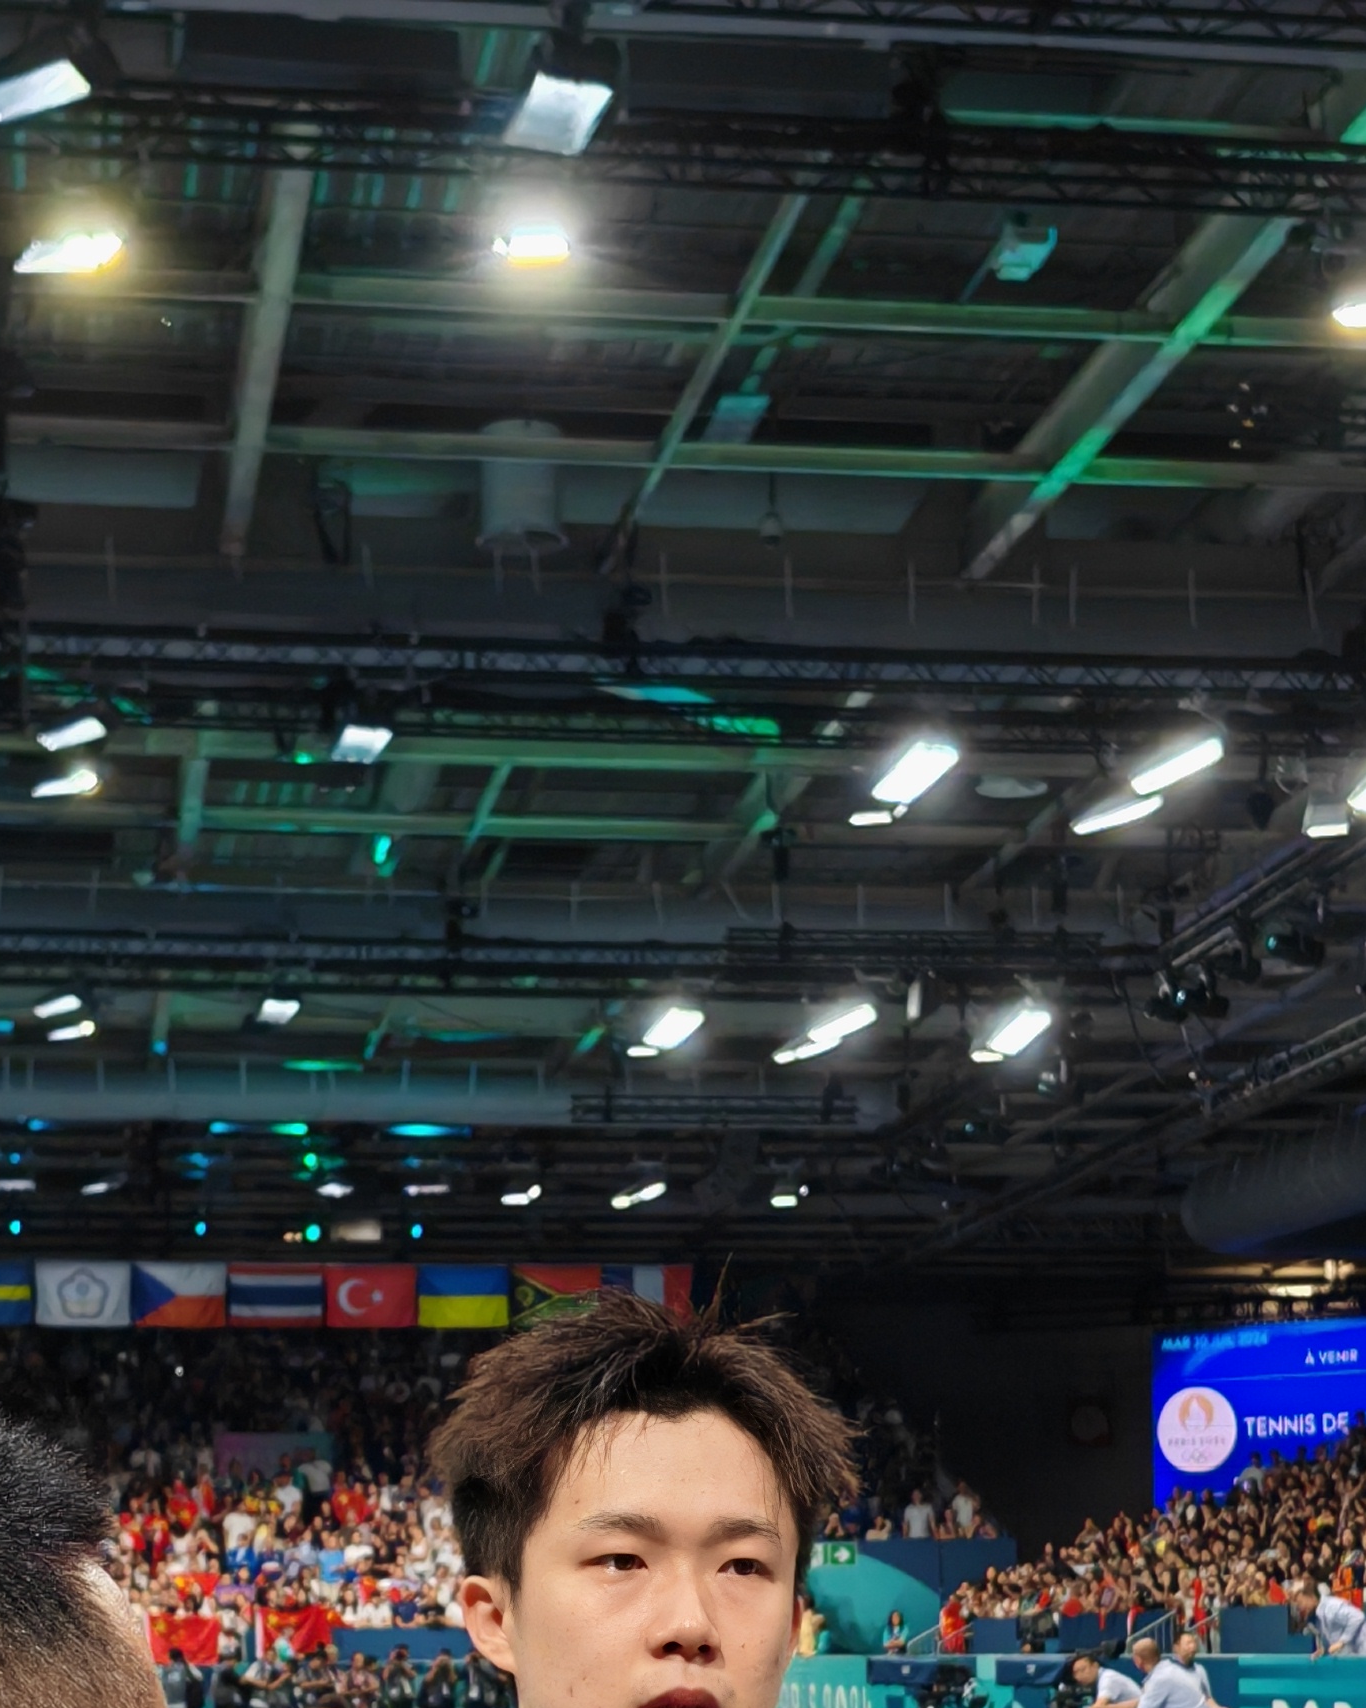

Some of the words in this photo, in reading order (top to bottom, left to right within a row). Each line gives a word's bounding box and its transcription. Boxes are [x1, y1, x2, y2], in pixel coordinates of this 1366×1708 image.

[1319, 1348, 1358, 1364] VENIR
[1243, 1412, 1317, 1438] TENNIS
[1321, 1411, 1349, 1435] DE
